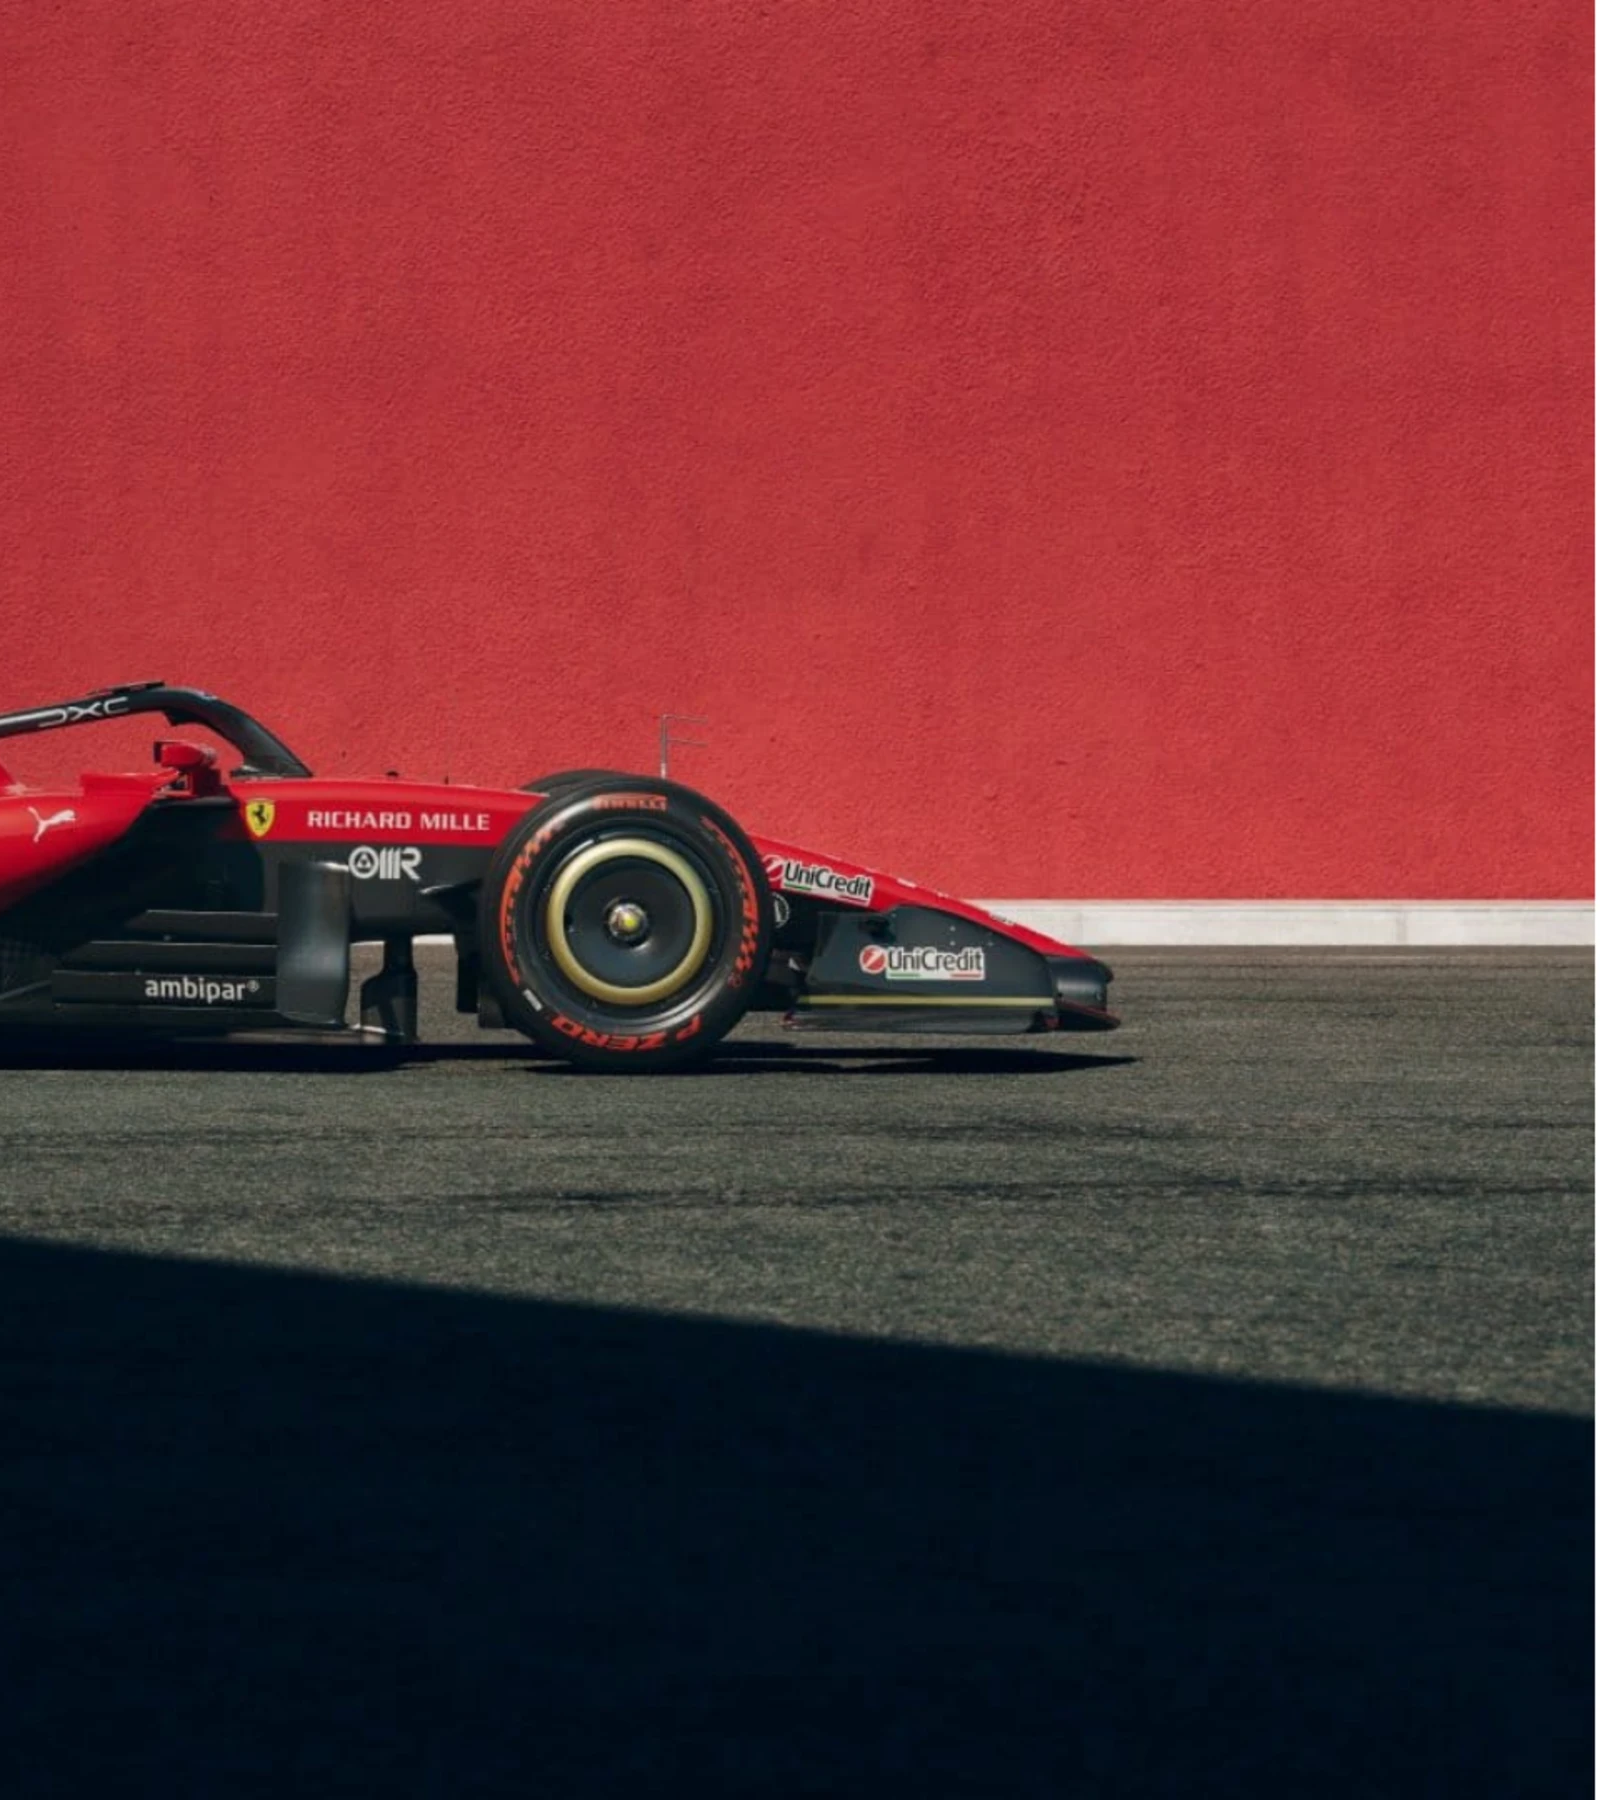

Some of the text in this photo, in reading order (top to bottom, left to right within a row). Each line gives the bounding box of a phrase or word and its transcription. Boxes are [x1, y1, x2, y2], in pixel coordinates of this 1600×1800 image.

[307, 811, 491, 832] RICHARD MILLE
[784, 861, 872, 898] UniCredit
[888, 948, 983, 971] UniCredit
